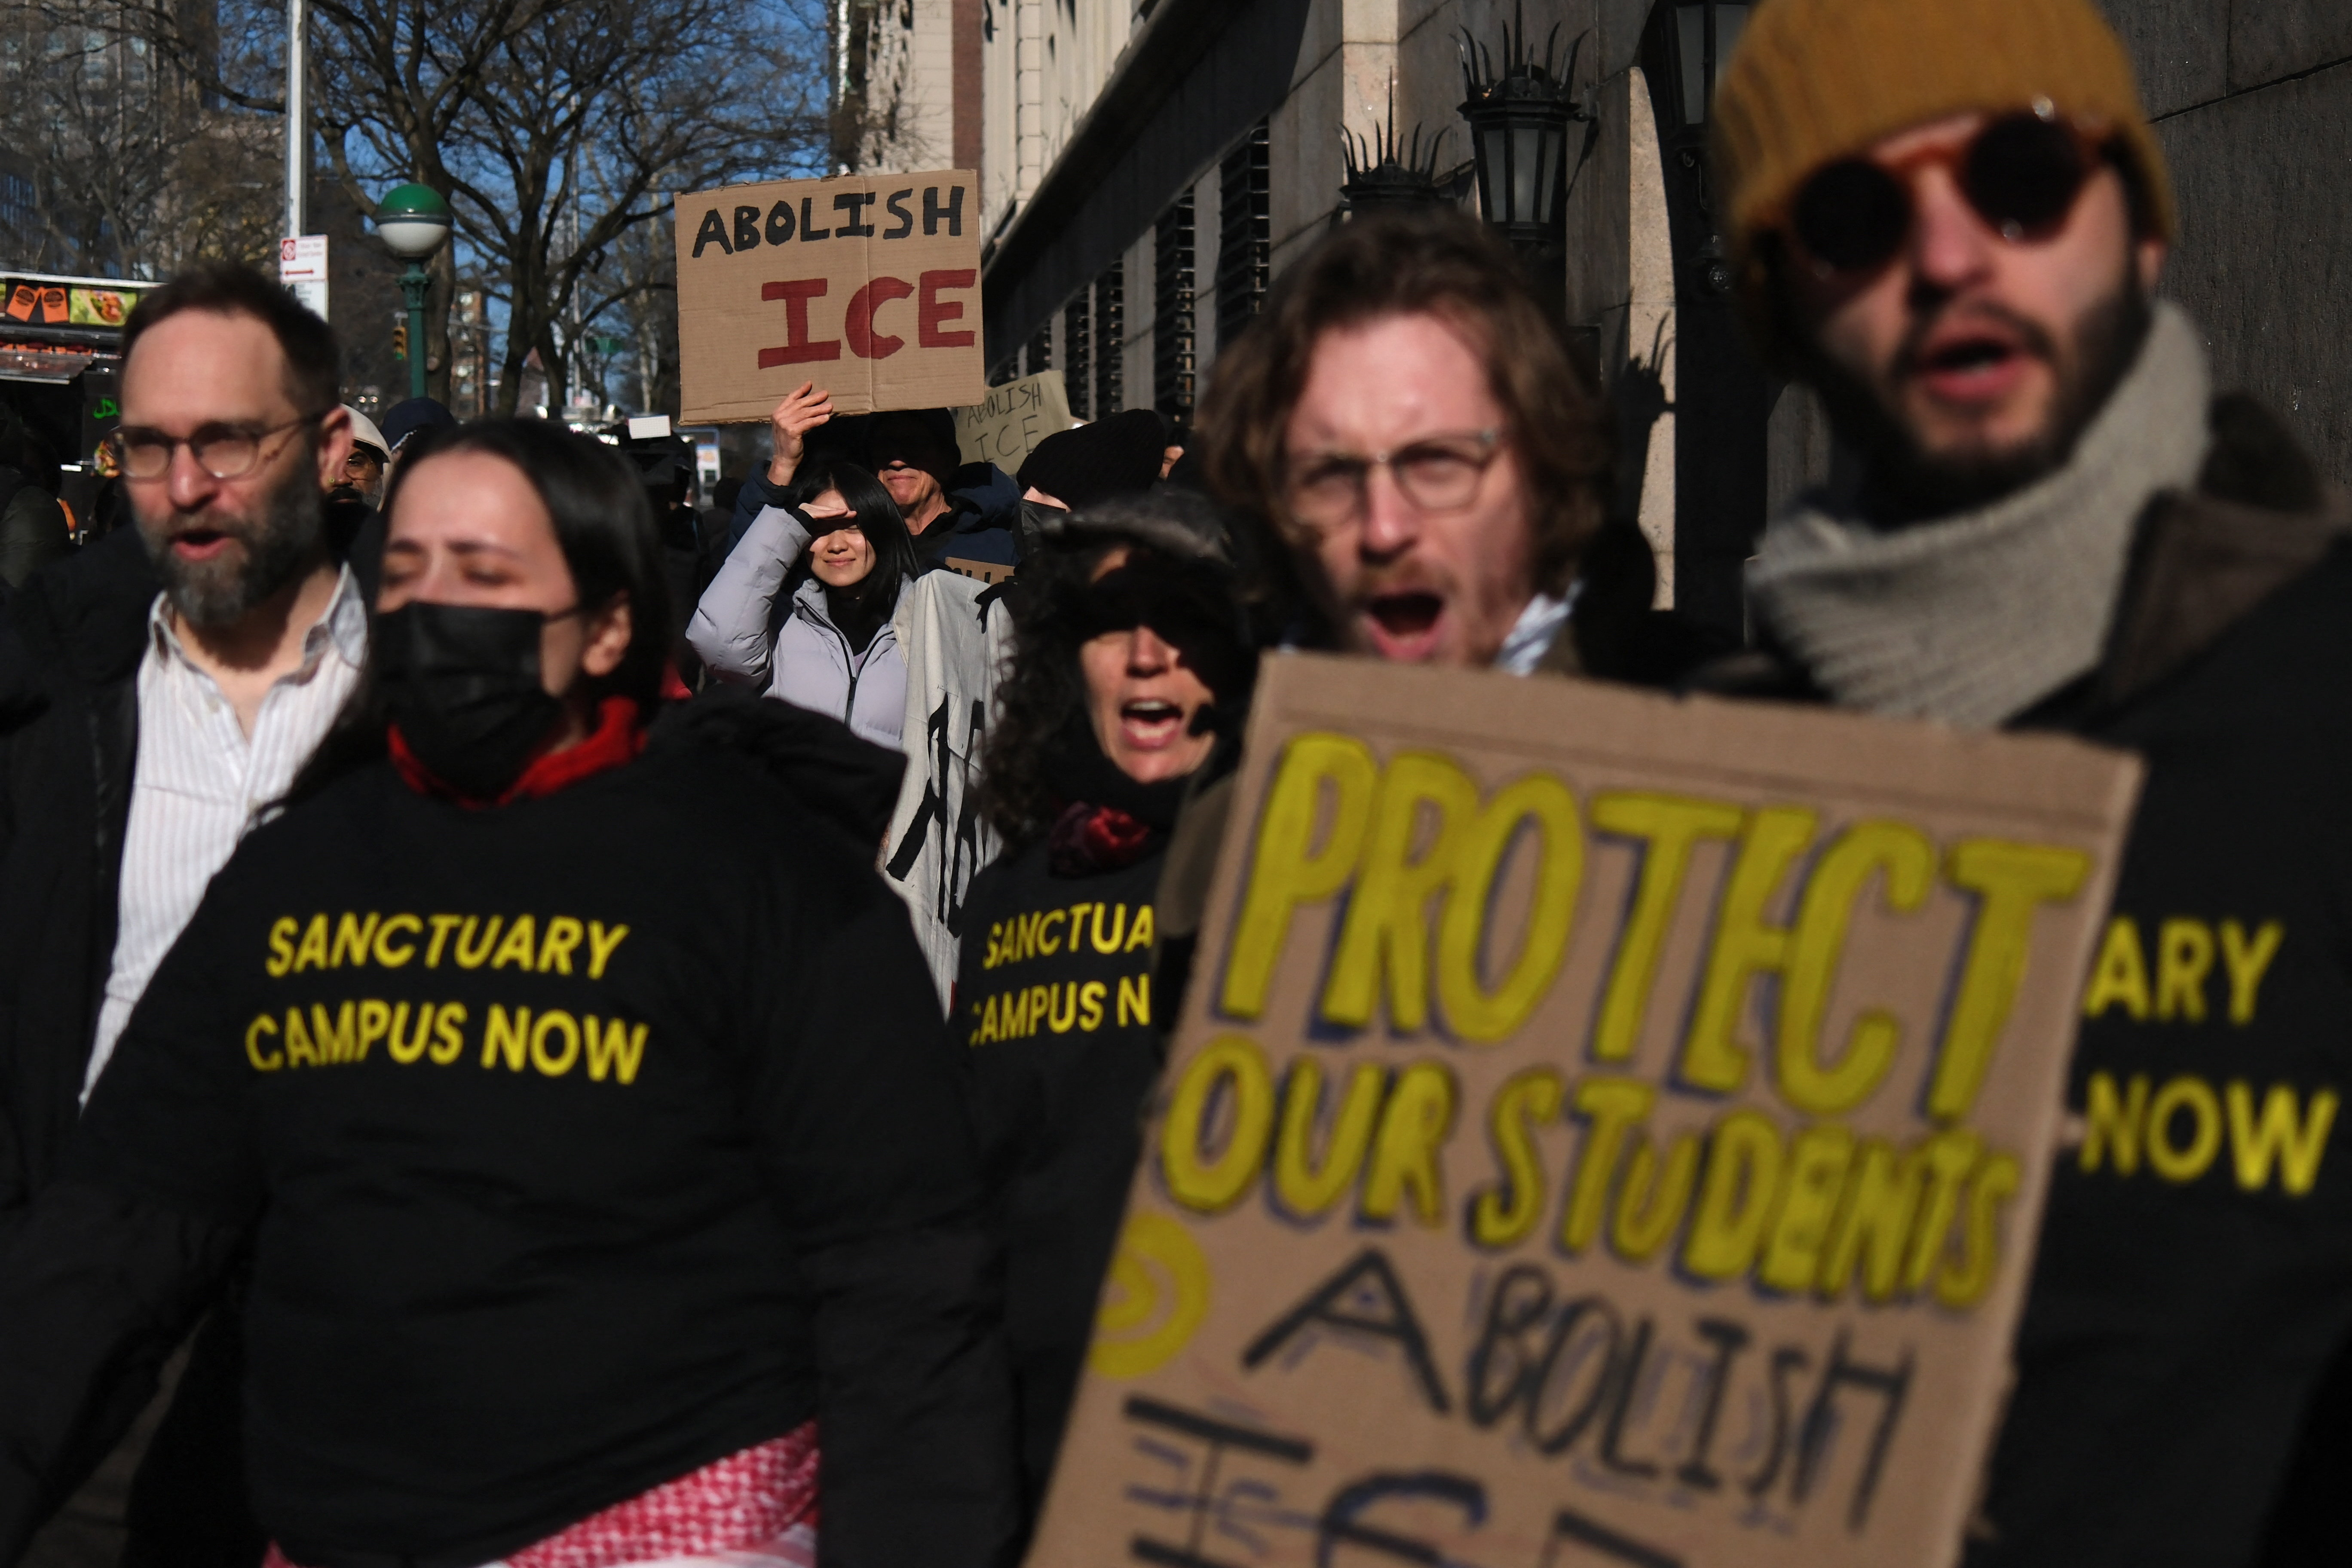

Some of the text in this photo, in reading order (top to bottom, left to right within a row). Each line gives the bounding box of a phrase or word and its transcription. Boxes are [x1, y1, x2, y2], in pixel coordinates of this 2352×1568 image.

[692, 186, 965, 258] ABOLISH
[758, 269, 977, 369] ICE
[968, 382, 1042, 429] ABOLISH
[974, 414, 1038, 463] ICE
[265, 911, 630, 980] SANCTUARY
[1216, 732, 2092, 1125] PROTECT
[244, 998, 650, 1085] CAMPUS NOW
[1158, 1036, 2022, 1309] OUR STUDENTS
[2078, 1068, 2340, 1197] NOW
[1238, 1246, 1918, 1535] ABOLISH
